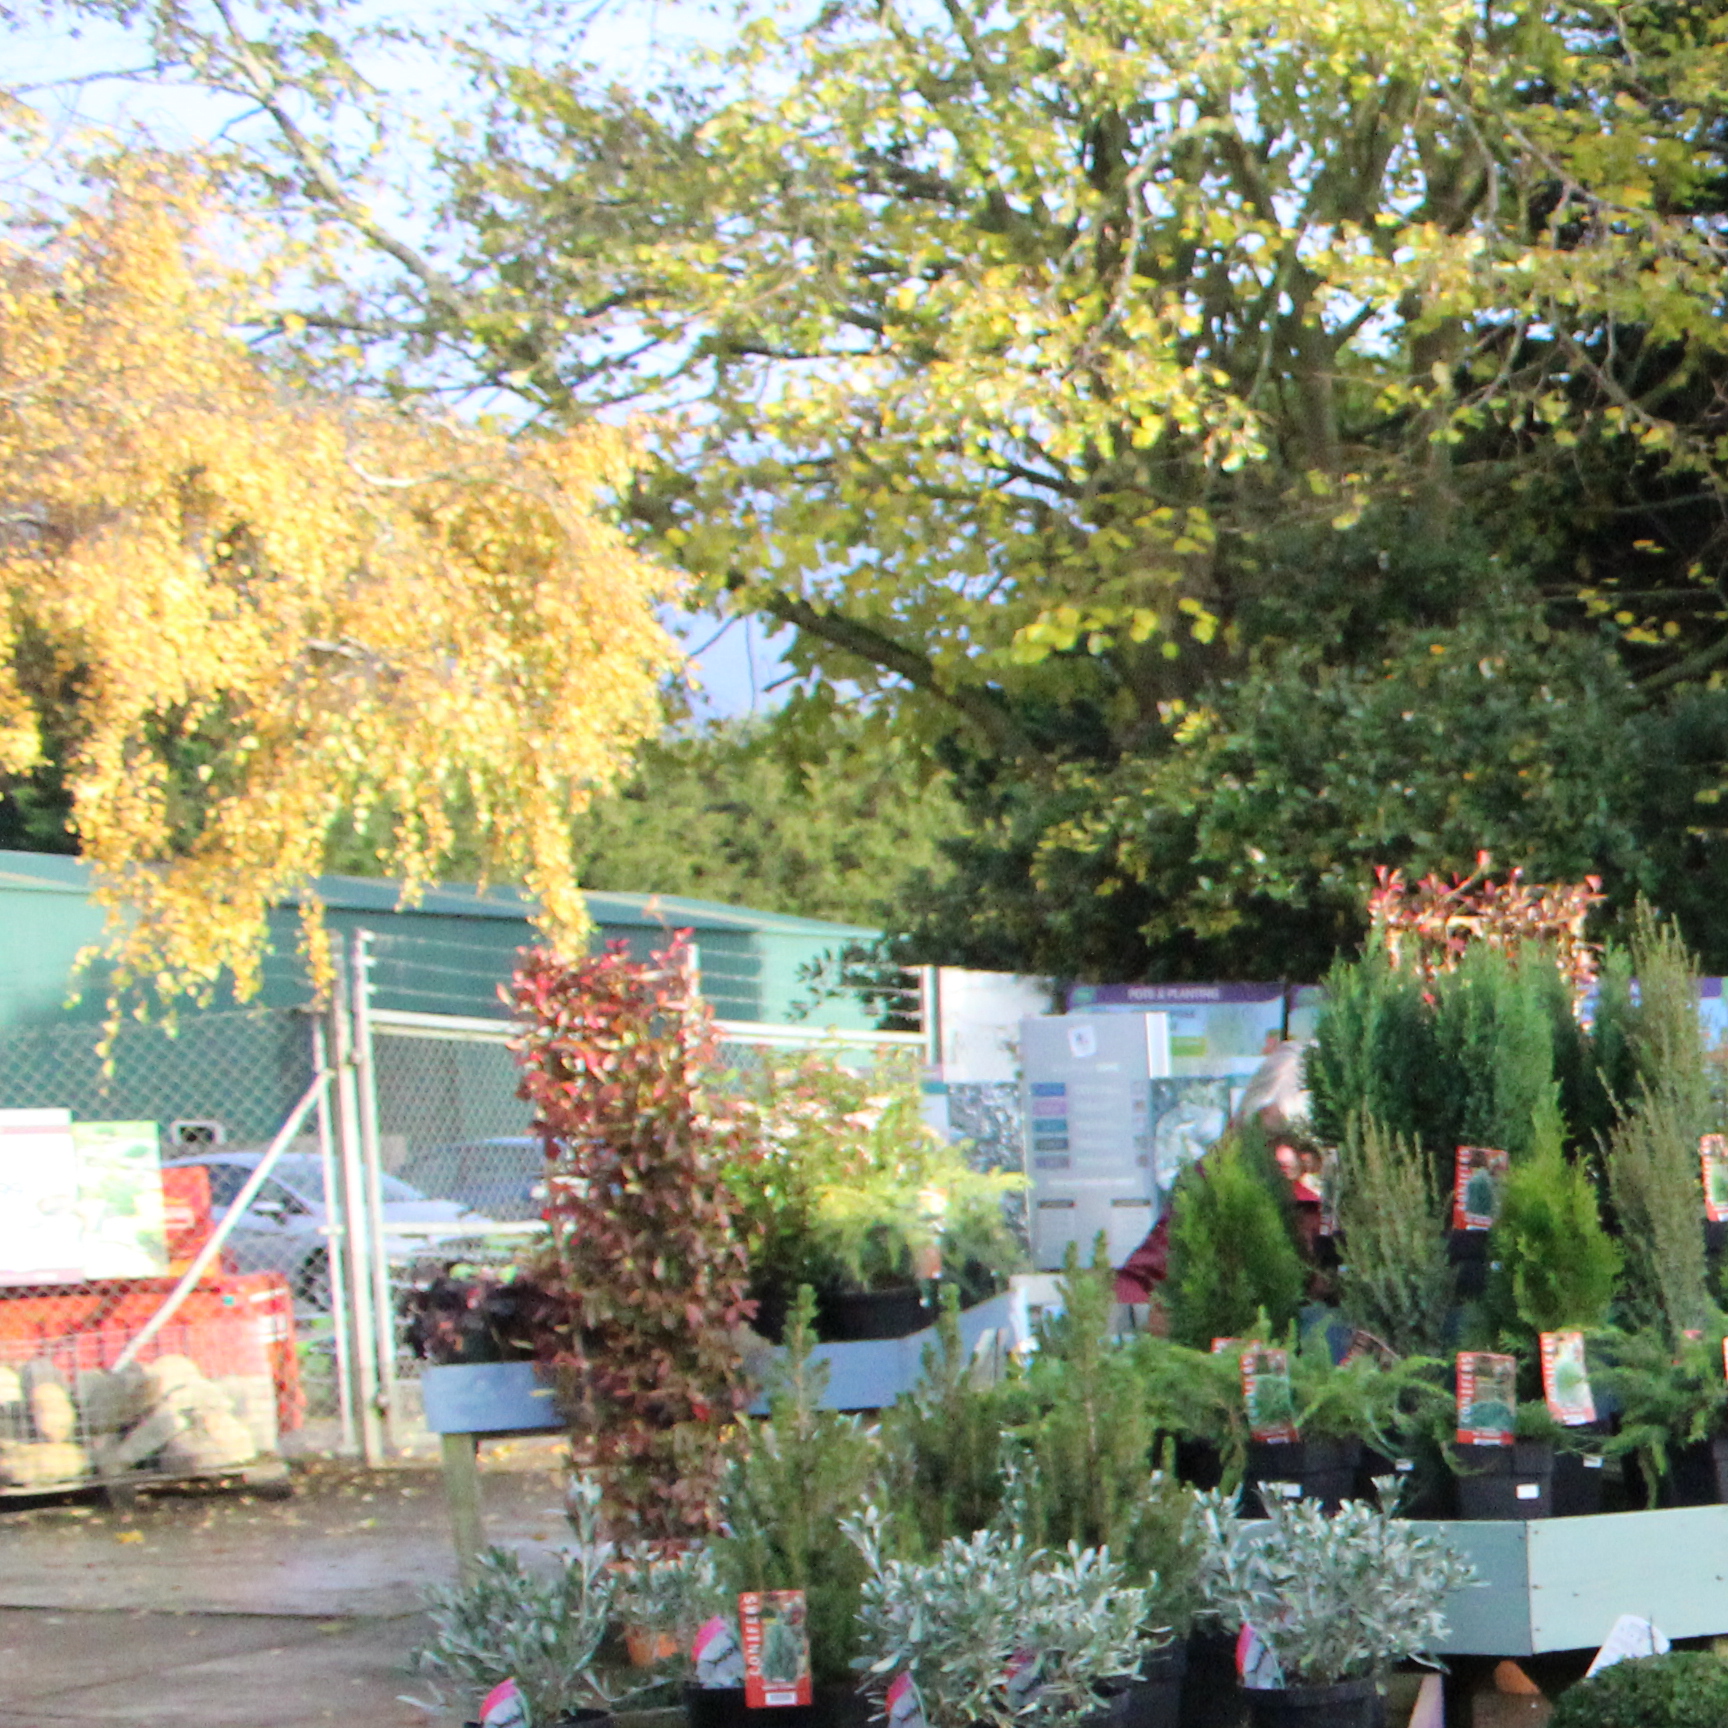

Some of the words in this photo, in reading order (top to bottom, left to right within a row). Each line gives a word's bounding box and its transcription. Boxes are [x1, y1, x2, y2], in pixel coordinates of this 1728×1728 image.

[1165, 986, 1221, 1001] PLANTING
[1459, 1355, 1476, 1424] CONIFERS
[743, 1593, 762, 1678] CONIFERS
